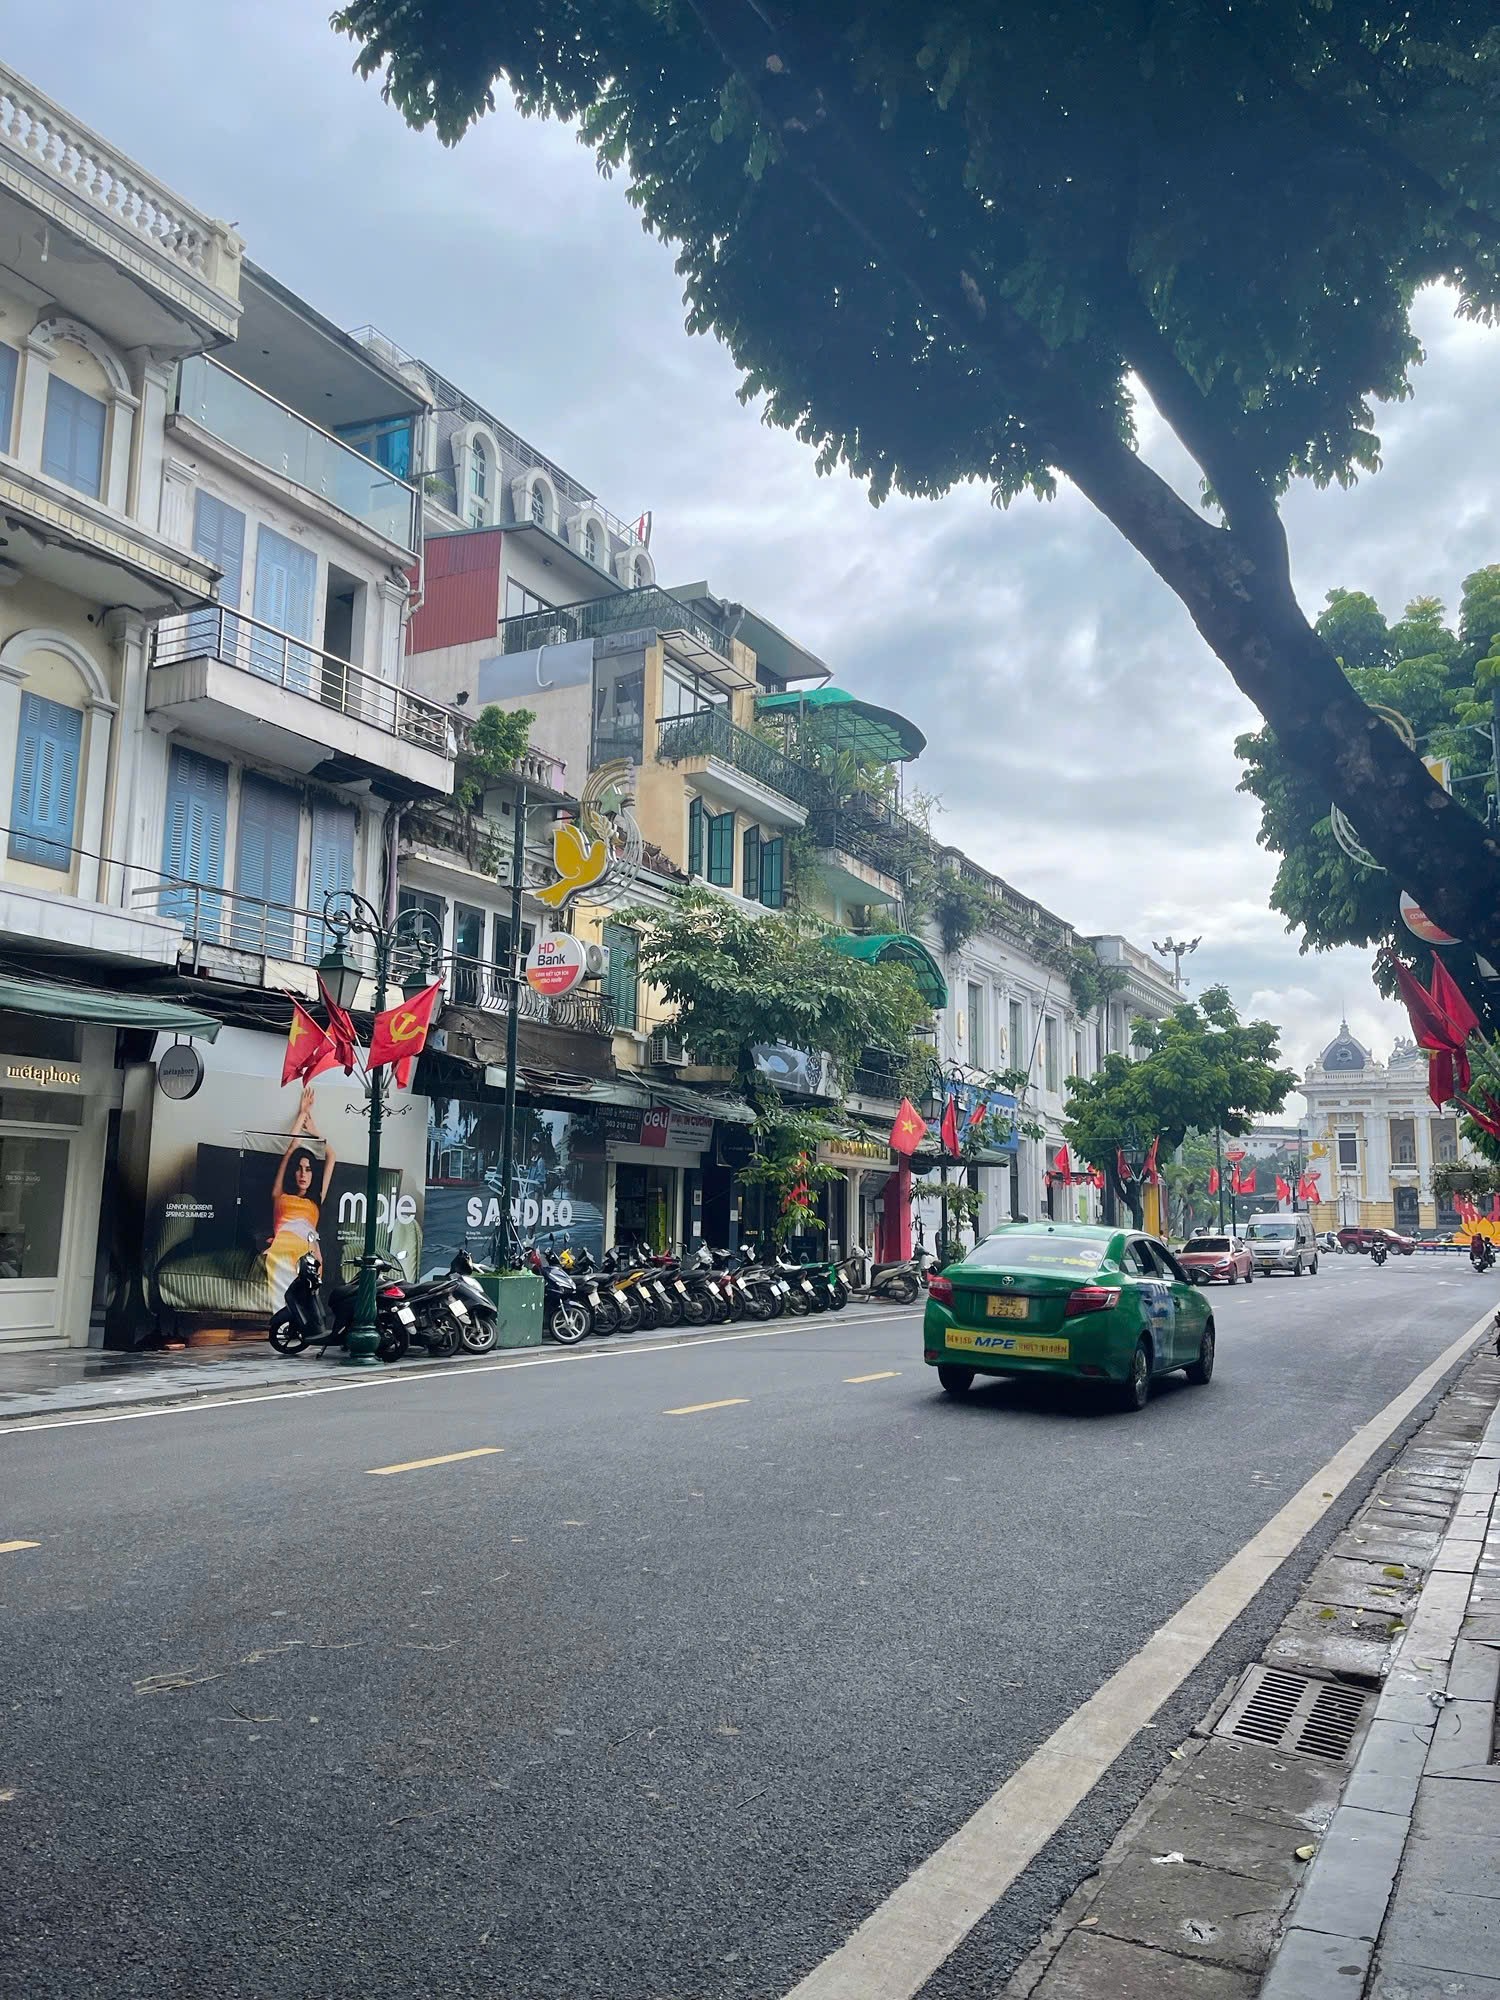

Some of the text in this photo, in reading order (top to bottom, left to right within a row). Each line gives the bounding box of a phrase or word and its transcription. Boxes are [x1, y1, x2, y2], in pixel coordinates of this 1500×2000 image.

[538, 943, 555, 954] HD
[537, 954, 566, 966] Bank
[8, 1065, 81, 1085] métaphore
[643, 1111, 668, 1128] deli
[466, 1197, 573, 1227] SANDRO
[974, 1336, 1016, 1349] MPE
